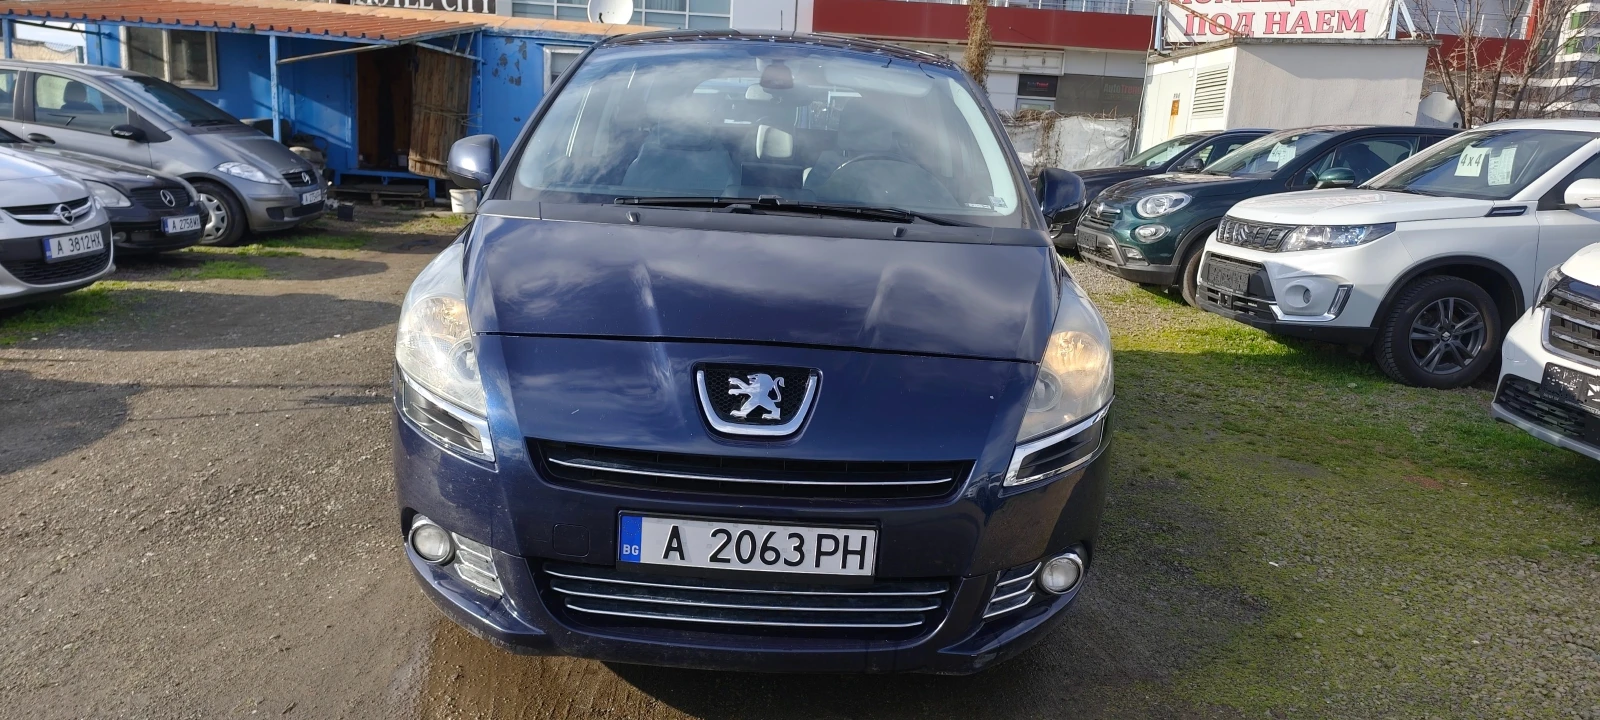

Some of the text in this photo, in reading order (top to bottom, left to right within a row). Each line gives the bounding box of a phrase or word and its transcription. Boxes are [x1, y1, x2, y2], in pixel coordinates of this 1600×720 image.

[1184, 9, 1368, 37] ПОД НАЕМ
[57, 240, 64, 255] A
[623, 544, 640, 556] BG
[662, 525, 686, 561] A
